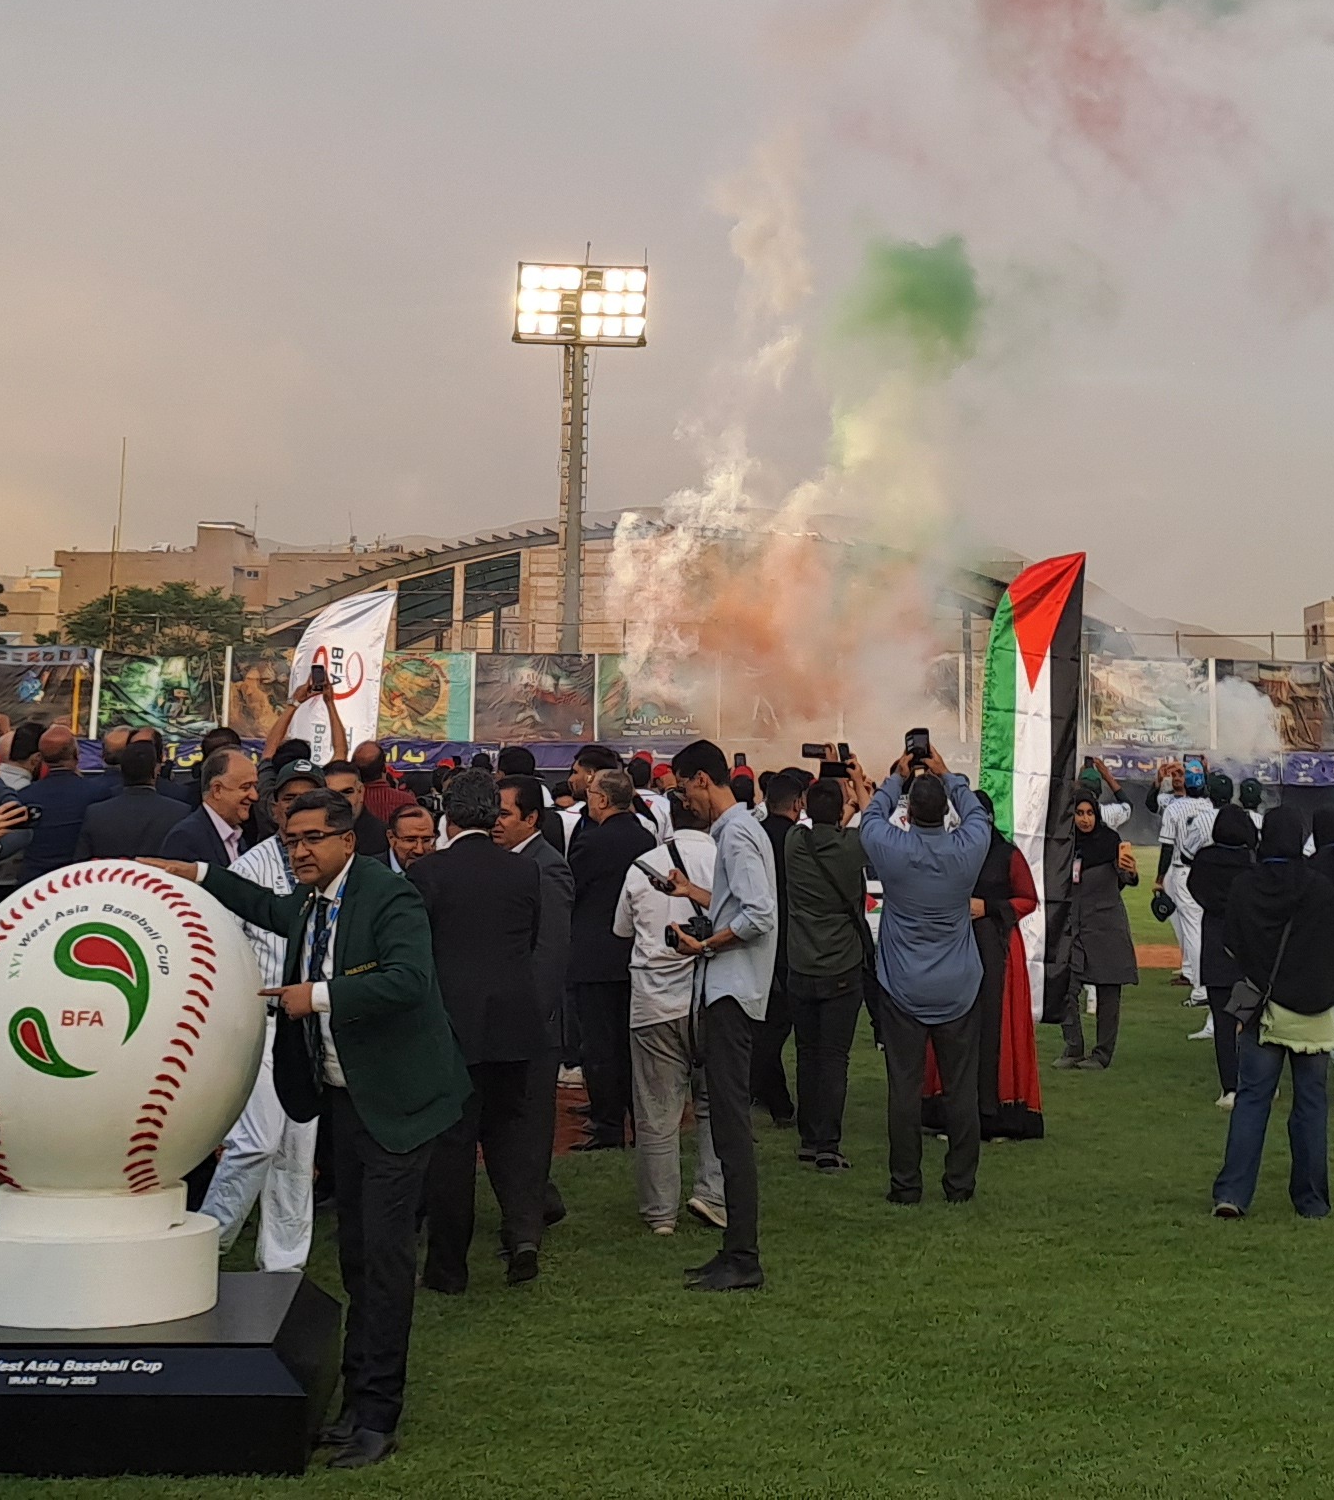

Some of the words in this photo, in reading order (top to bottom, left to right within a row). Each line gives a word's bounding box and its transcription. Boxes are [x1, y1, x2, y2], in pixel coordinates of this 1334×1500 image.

[330, 646, 344, 686] BFA
[312, 723, 326, 763] Base
[8, 952, 24, 980] XVI
[18, 918, 52, 948] West
[54, 904, 90, 922] Asia
[101, 903, 162, 941] Baseball
[155, 943, 170, 976] Cup
[60, 1009, 105, 1028] BFA
[23, 1359, 61, 1372] Asia
[62, 1359, 130, 1372] Baseball
[131, 1359, 163, 1374] Cup
[46, 1376, 70, 1387] May
